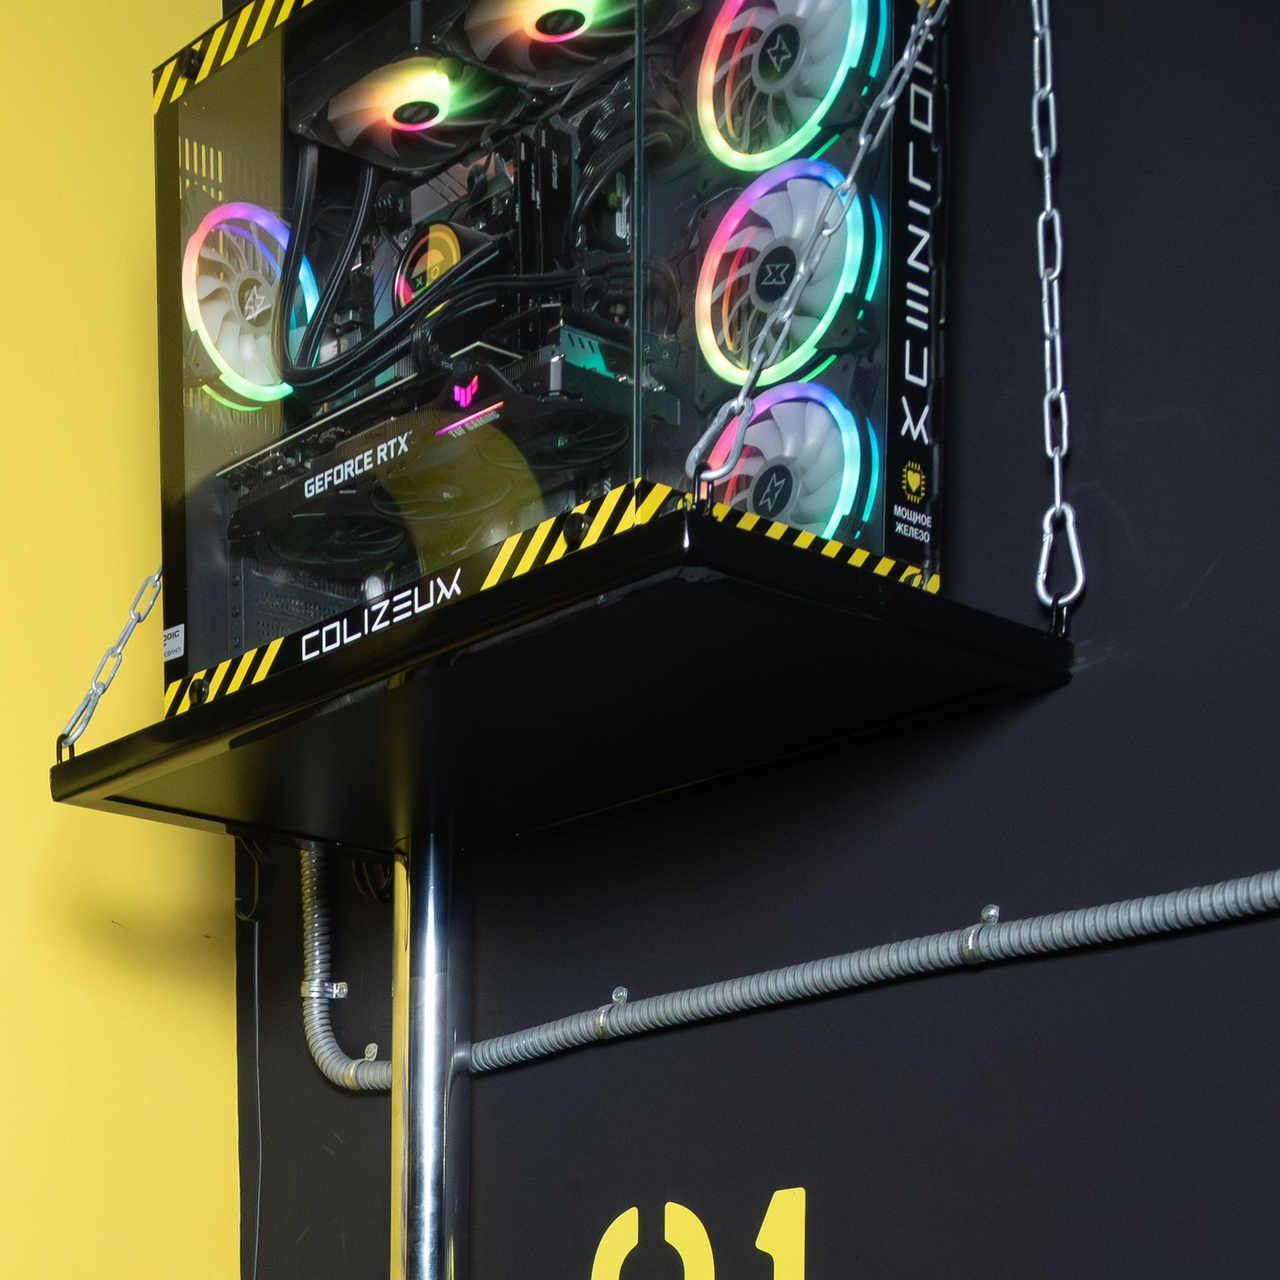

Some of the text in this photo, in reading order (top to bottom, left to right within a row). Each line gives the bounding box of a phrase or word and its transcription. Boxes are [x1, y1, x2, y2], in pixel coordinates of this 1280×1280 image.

[304, 432, 409, 499] GEFORCE RTX
[893, 504, 932, 528] МОЩНОЕ
[895, 521, 930, 543] ЖЕЛЕЗО
